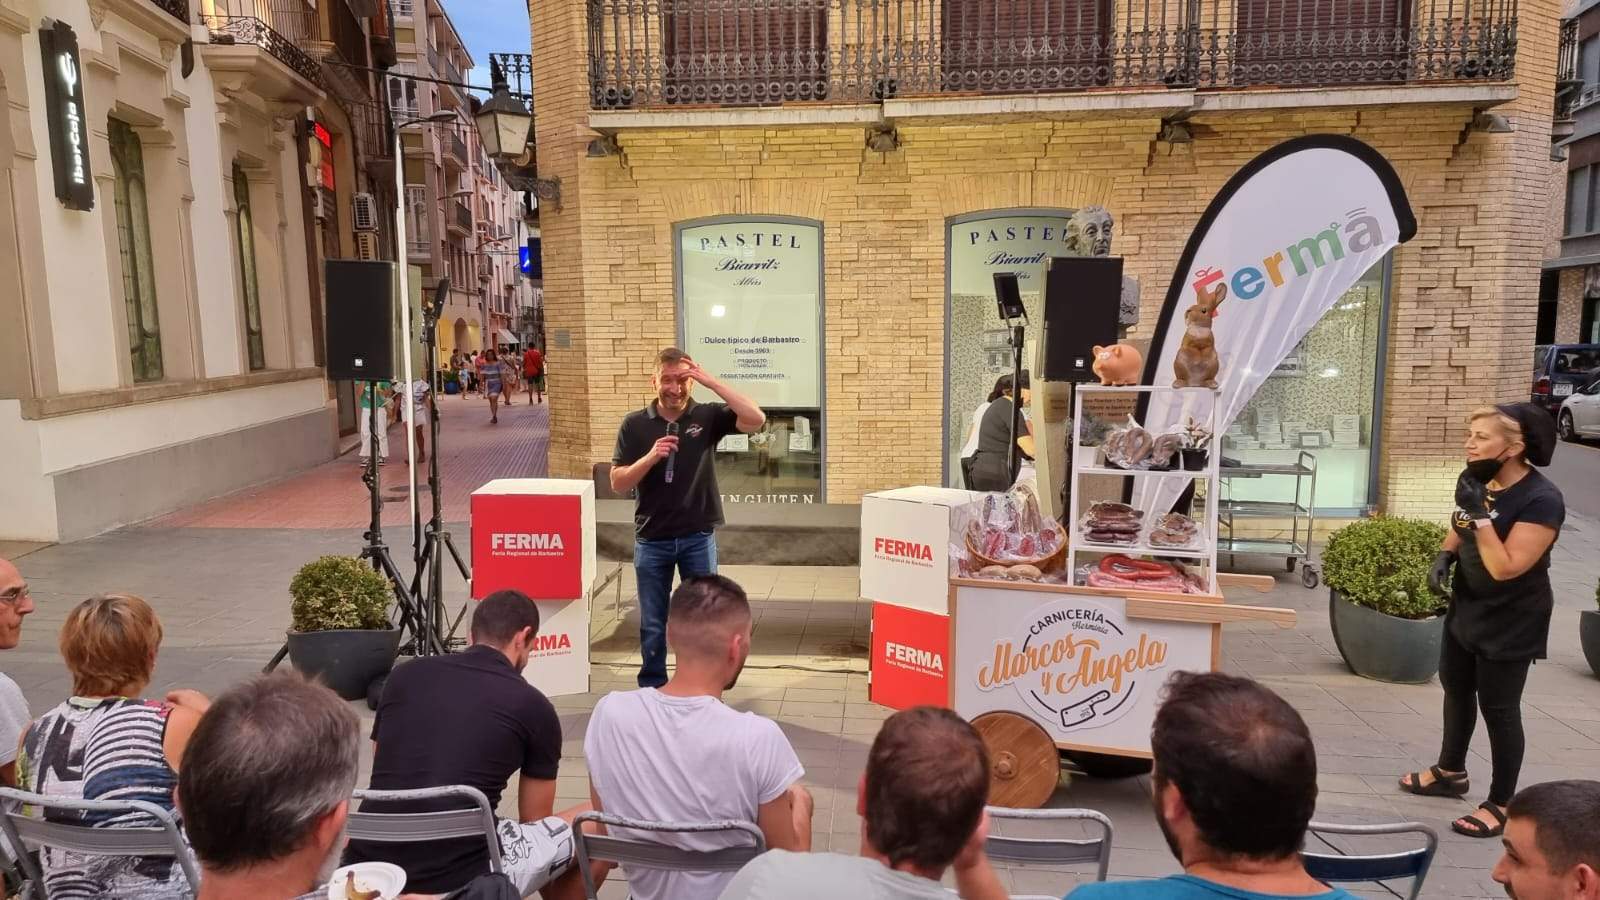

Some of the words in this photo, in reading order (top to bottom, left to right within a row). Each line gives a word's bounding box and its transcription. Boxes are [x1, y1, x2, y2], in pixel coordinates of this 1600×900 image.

[68, 101, 85, 184] ibercaja
[700, 233, 801, 250] PASTEL
[715, 257, 781, 271] Biarritz
[984, 251, 1048, 265] Biarrit
[704, 336, 726, 344] Dulce
[751, 336, 761, 344] de
[762, 336, 800, 344] Barbastro
[720, 494, 741, 503] IN
[491, 533, 564, 549] FERMA
[874, 537, 934, 561] FERMA
[1030, 608, 1105, 636] CARNICERÍA
[533, 633, 571, 651] RMA
[885, 641, 944, 672] FERMA
[978, 633, 1077, 688] Marcos
[1041, 671, 1053, 695] y
